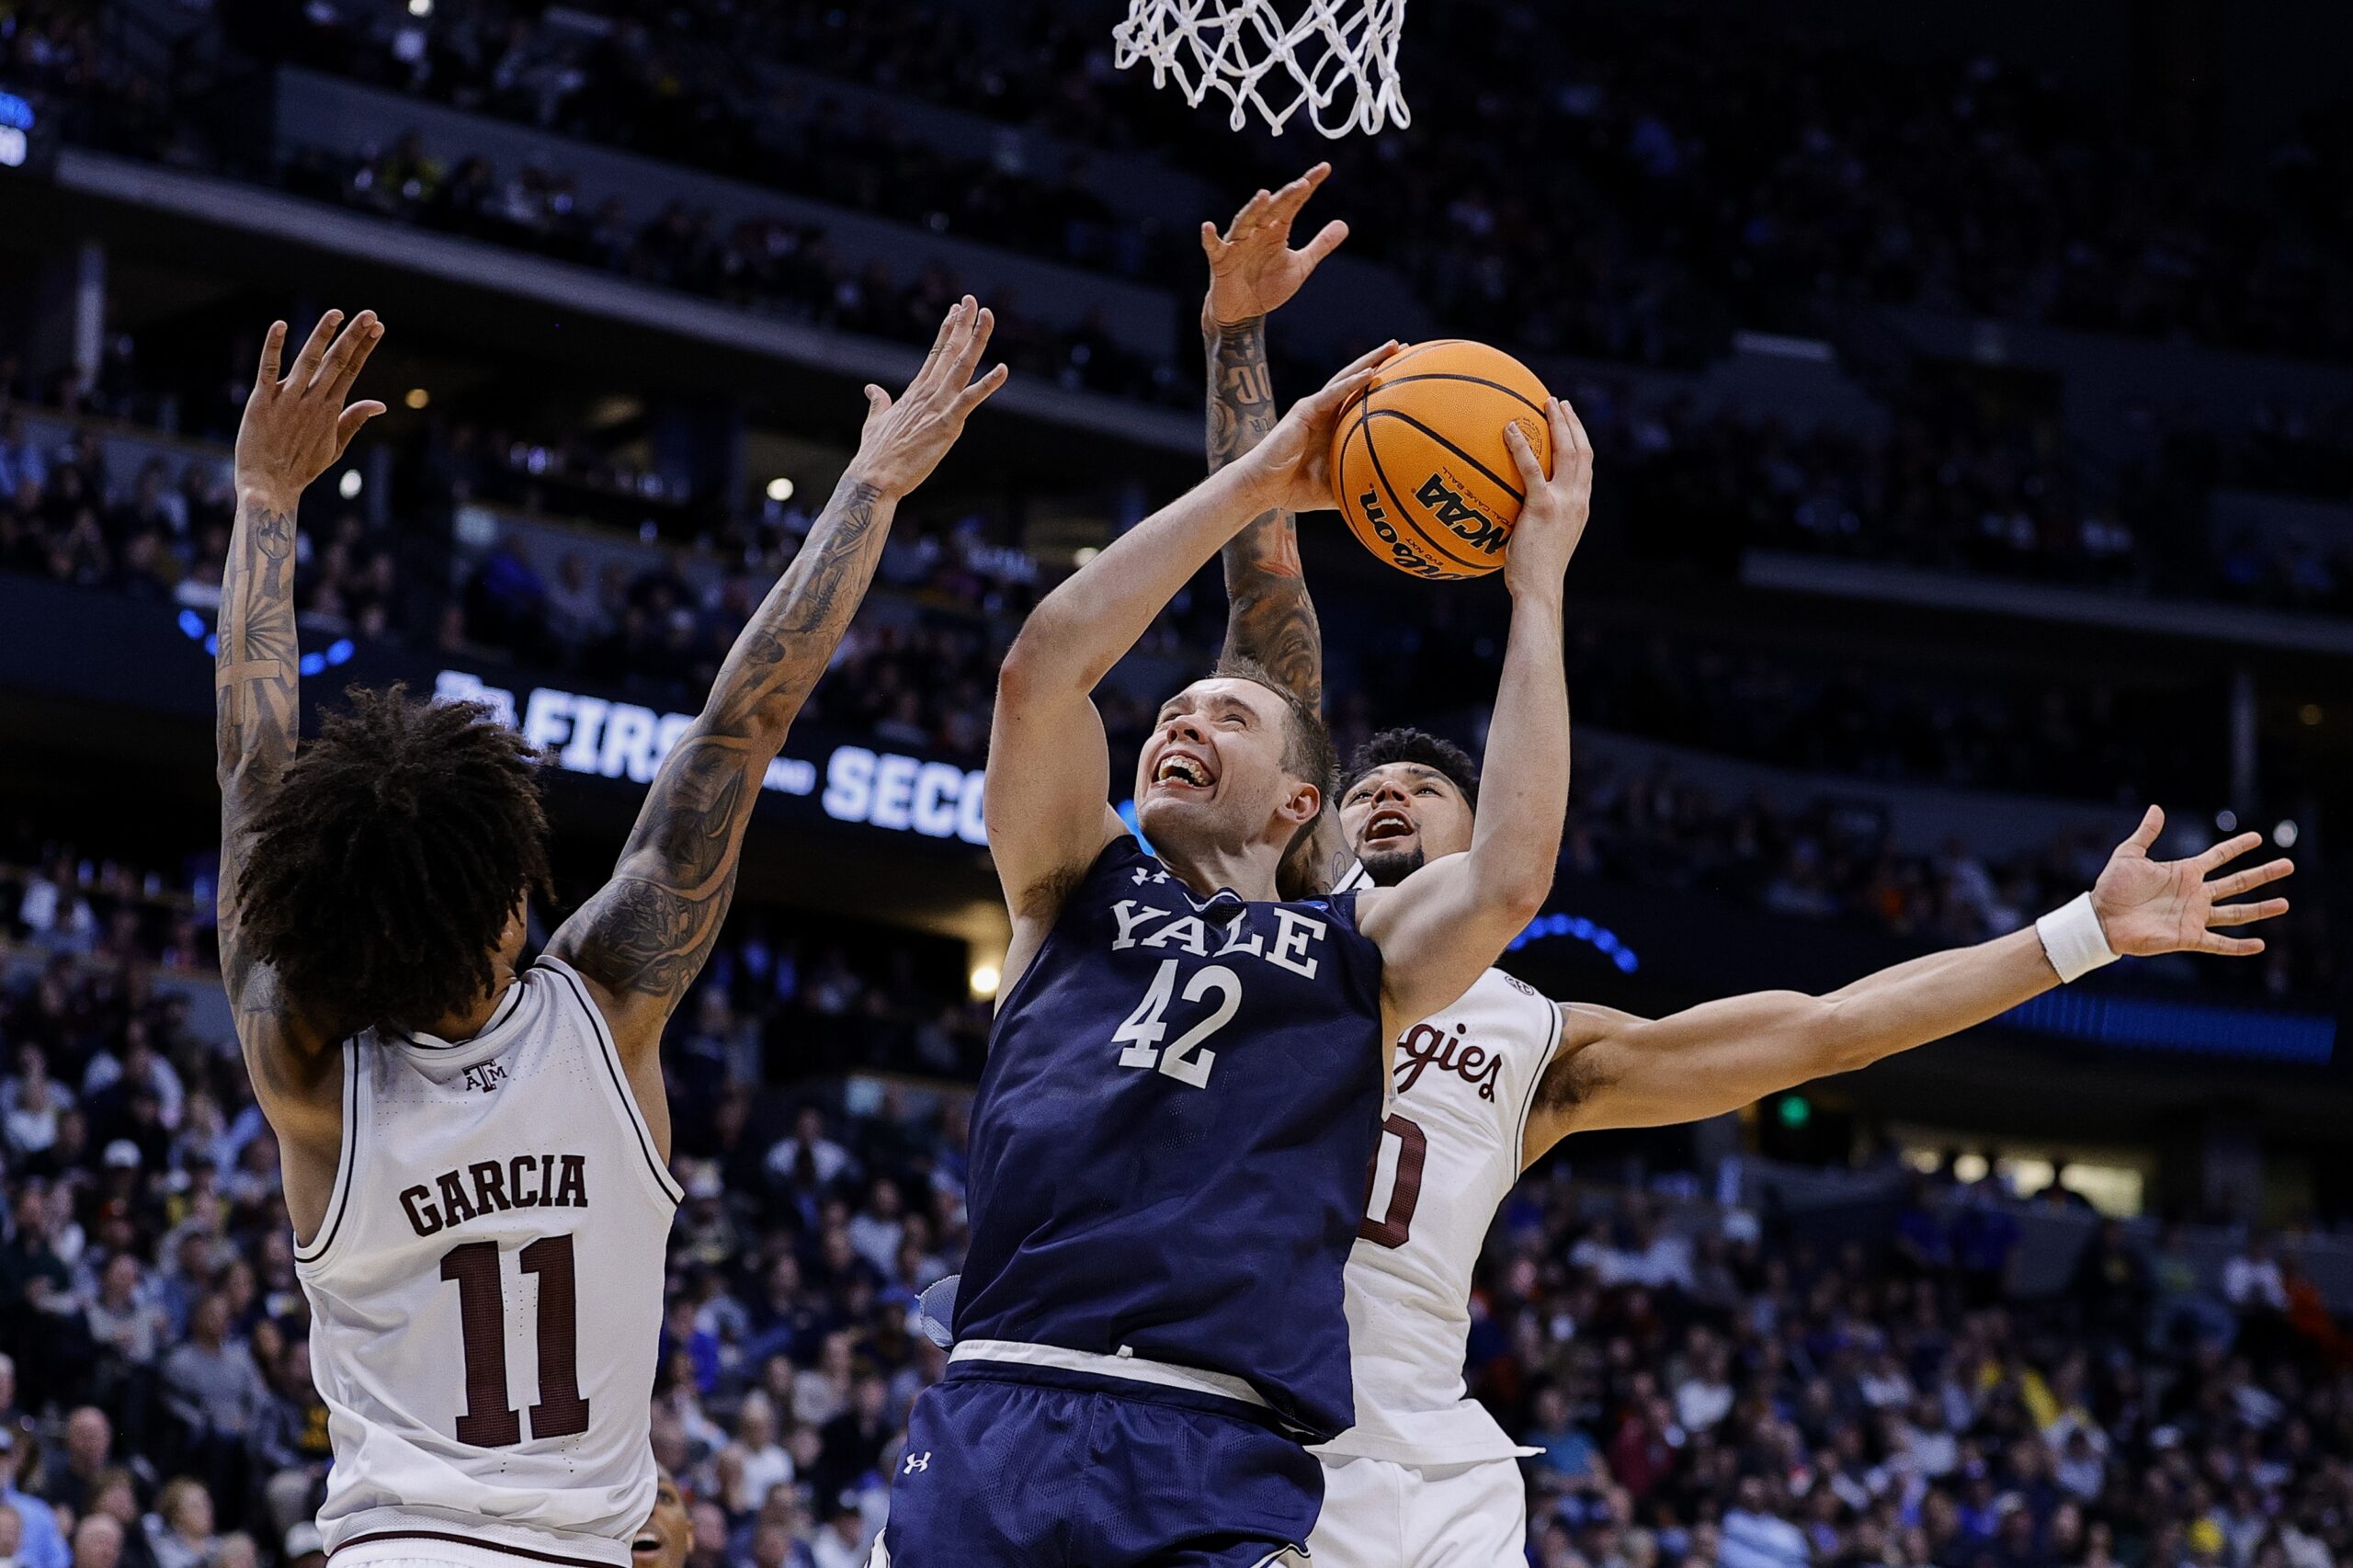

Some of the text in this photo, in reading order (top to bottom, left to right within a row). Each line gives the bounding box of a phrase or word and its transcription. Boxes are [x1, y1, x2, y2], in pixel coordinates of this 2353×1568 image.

[1414, 471, 1513, 556] NCAA
[1442, 466, 1465, 491] BALL
[1463, 489, 1491, 513] GAME
[1405, 538, 1425, 553] NXT
[522, 687, 698, 784] FIRS
[822, 744, 990, 846] SECO
[1109, 899, 1327, 980] YALE
[1110, 959, 1243, 1089] 42
[1393, 1023, 1503, 1104] gies
[399, 1154, 588, 1237] GARCIA
[439, 1233, 590, 1449] 11
